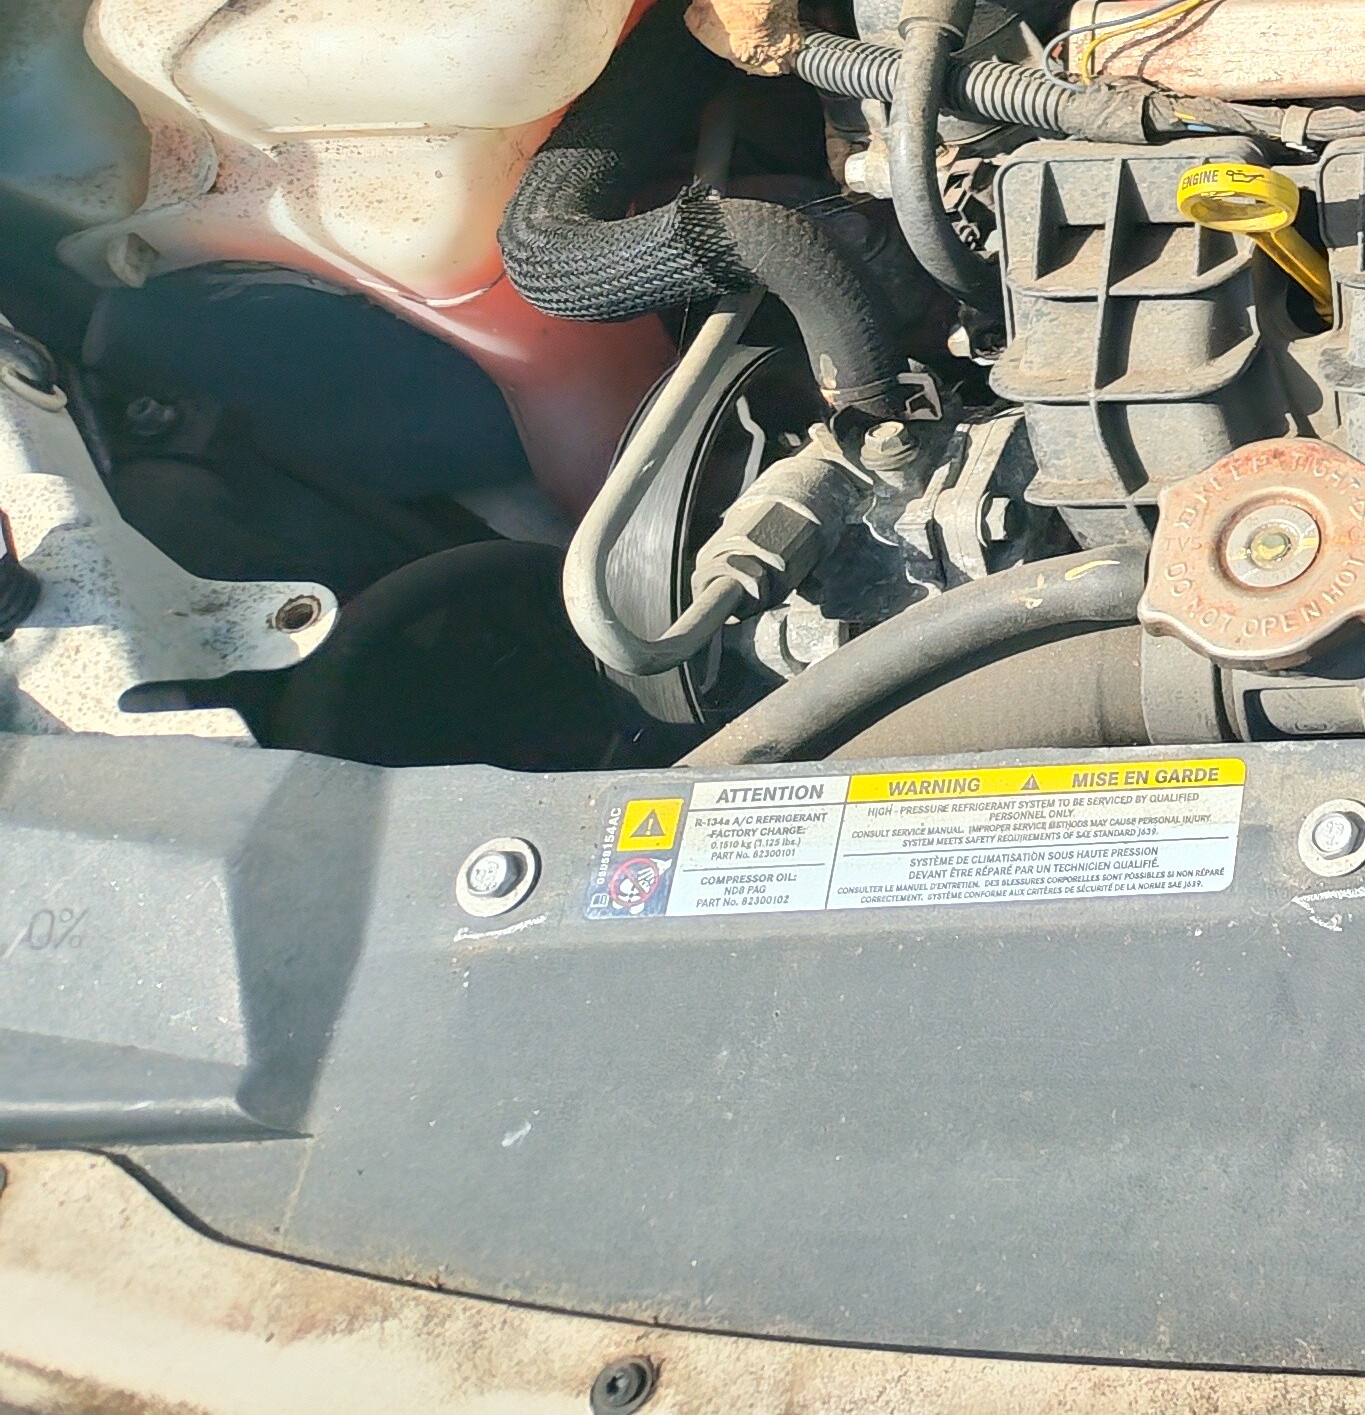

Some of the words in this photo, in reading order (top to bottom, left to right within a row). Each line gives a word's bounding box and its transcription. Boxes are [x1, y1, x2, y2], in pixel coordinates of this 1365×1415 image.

[1181, 169, 1220, 190] ENGINE
[1290, 451, 1361, 495] TIGHT
[1164, 562, 1193, 598] DO
[1182, 598, 1234, 635] NOT
[1240, 600, 1322, 639] OPEN
[1322, 557, 1365, 607] HOT
[888, 777, 981, 796] WARNING
[1072, 771, 1119, 788] MISE
[1123, 770, 1149, 786] EN
[1155, 767, 1220, 784] GARDE
[716, 783, 824, 804] ATTENTION
[868, 804, 892, 817] HIGH
[900, 803, 950, 816] PRESSURE
[951, 800, 1017, 813] REFRIGERANT
[1018, 798, 1055, 809] SYSTEM
[1058, 797, 1070, 807] TO
[1072, 796, 1085, 807] BE
[1087, 795, 1132, 806] SERVICED
[1135, 794, 1149, 804] BY
[1150, 792, 1200, 804] QUALIFIED
[695, 817, 730, 827] R-134a
[732, 815, 754, 826] A/C
[756, 812, 828, 824] REFRIGERANT
[989, 810, 1046, 821] PERSONNEL
[709, 827, 759, 838] FACTORY
[852, 829, 890, 839] CONSULT
[892, 827, 925, 837] SERVICE
[969, 823, 1011, 834] IMPROPER
[1012, 821, 1047, 831] SERVICE
[1090, 818, 1108, 828] MAY
[1109, 817, 1136, 827] CAUSE
[1137, 815, 1181, 825] PERSONAL
[741, 840, 752, 850] kg
[902, 838, 934, 847] SYSTEM
[936, 836, 963, 846] MEETS
[965, 835, 996, 844] SAFETY
[997, 832, 1061, 843] REQUIREMENTS
[1063, 831, 1074, 840] OF
[1093, 828, 1136, 838] STANDARD
[711, 851, 734, 860] PART
[909, 853, 954, 867] SYSTÈME
[956, 854, 969, 865] DE
[971, 851, 1045, 865] CLIMATISATION
[1047, 850, 1075, 860] SOUS
[1077, 848, 1109, 859] HAUTE
[1110, 846, 1158, 857] PRESSION
[700, 873, 774, 886] COMPRESSOR
[776, 873, 797, 882] OIL:
[908, 869, 948, 880] DEVANT
[950, 866, 973, 878] ÊTRE
[975, 864, 1013, 877] RÉPARÉ
[1015, 864, 1034, 874] PAR
[1036, 863, 1051, 873] UN
[1053, 860, 1111, 872] TECHNICIEN
[747, 885, 766, 894] PAG
[837, 885, 883, 895] CONSULTER
[884, 884, 895, 893] LE
[895, 883, 929, 892] MANUEL
[985, 879, 1000, 888] DES
[1001, 877, 1045, 887] BLESSURES
[1046, 873, 1101, 884] CORPORELLES
[1102, 872, 1122, 881] SONT
[1124, 870, 1166, 881] POSSIBLES
[1167, 870, 1175, 878] SI
[1176, 869, 1193, 878] NON
[1195, 866, 1225, 877] RÉPARÉ
[927, 891, 963, 901] SYSTÈME
[964, 889, 1007, 899] CONFORME
[1009, 888, 1025, 897] AUX
[1026, 886, 1062, 896] CRITÈRES
[1064, 885, 1075, 894] DE
[1076, 882, 1113, 893] SÉCURITÉ
[1115, 883, 1125, 891] DE
[1126, 882, 1136, 890] LA
[1138, 881, 1166, 890] NORME
[1168, 879, 1182, 888] SAE
[696, 898, 721, 908] PART
[723, 897, 738, 907] No.
[741, 895, 790, 906] 82300102
